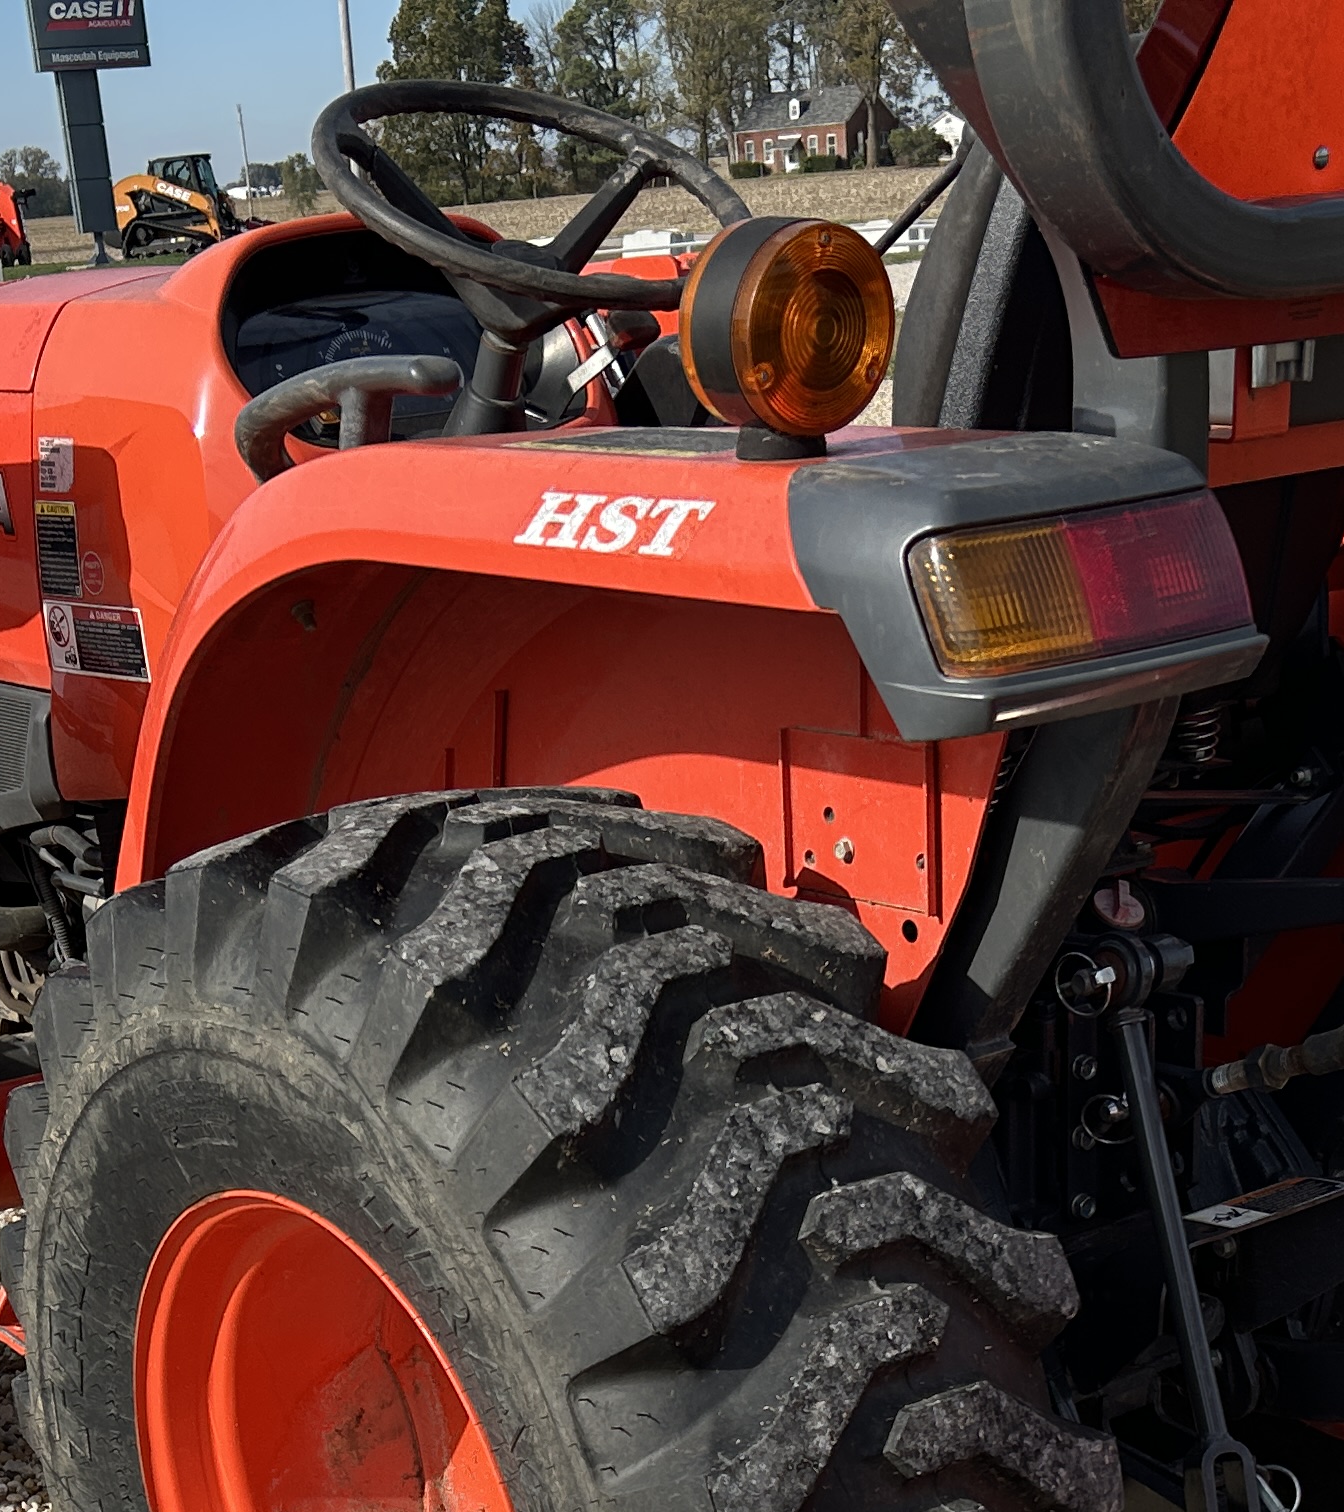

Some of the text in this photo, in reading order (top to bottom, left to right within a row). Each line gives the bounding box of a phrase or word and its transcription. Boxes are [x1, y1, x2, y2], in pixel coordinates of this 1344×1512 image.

[49, 1, 113, 20] CASE
[51, 50, 140, 63] Mascoutah Equipment
[156, 182, 192, 202] CASE
[46, 504, 71, 515] CAUTION
[513, 488, 716, 558] HST
[95, 611, 122, 622] DANGER
